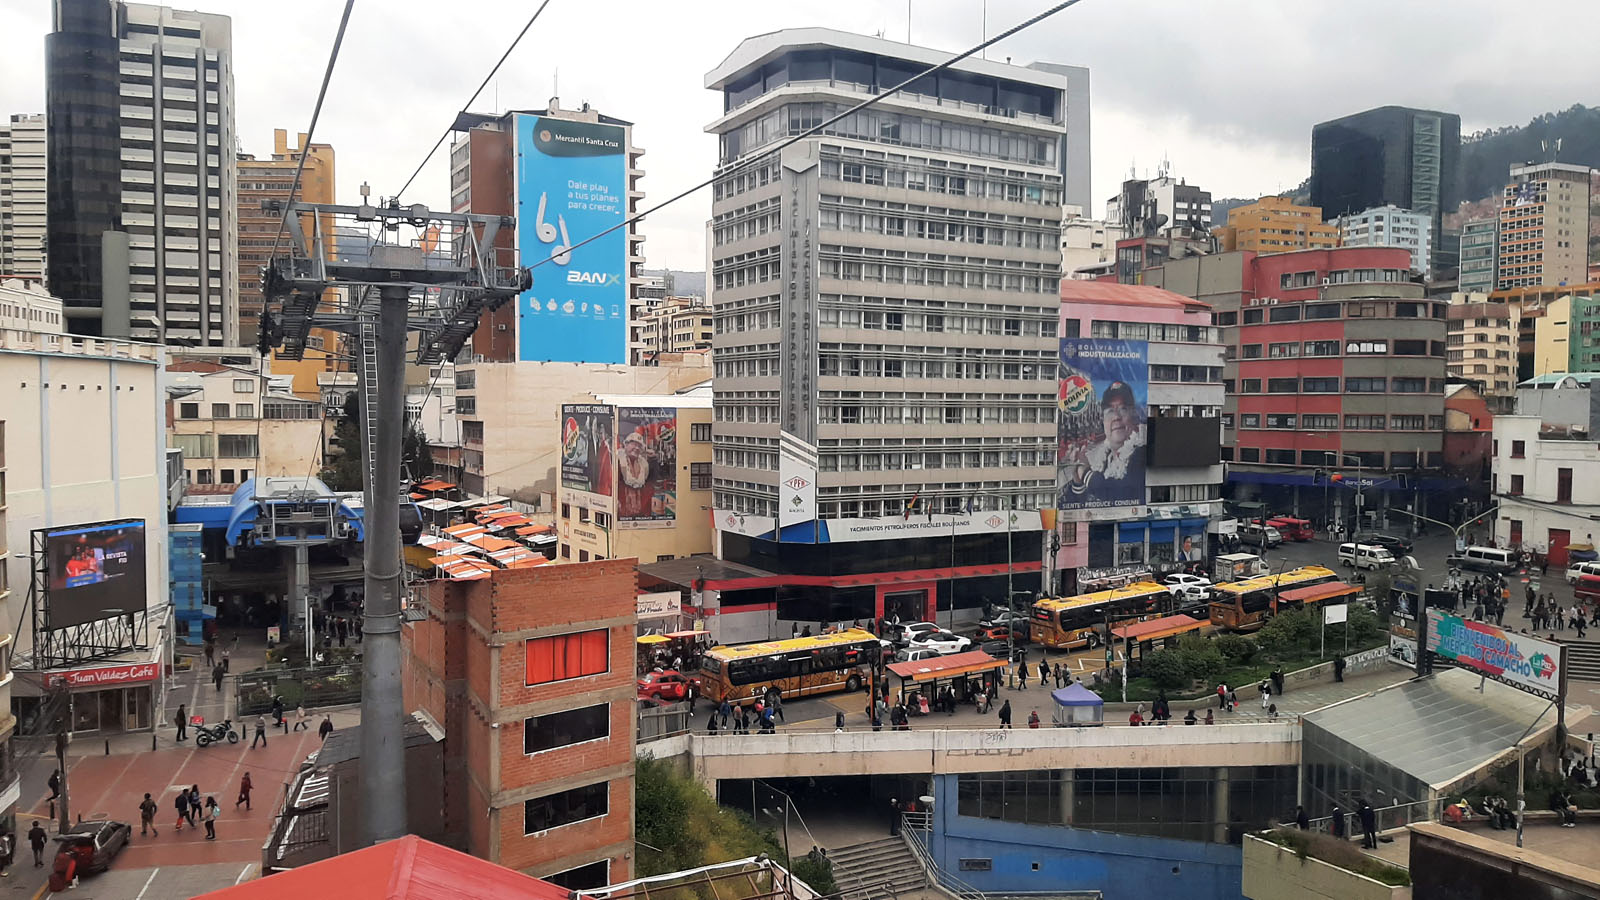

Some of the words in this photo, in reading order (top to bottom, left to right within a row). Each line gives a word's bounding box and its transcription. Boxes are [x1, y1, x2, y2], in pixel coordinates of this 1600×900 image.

[555, 134, 585, 144] Mercantil
[586, 137, 604, 146] Santa
[604, 139, 619, 147] Cruz
[568, 180, 588, 190] Dale
[590, 183, 609, 194] play
[575, 191, 589, 200] tus
[591, 193, 619, 203] planes
[568, 201, 587, 210] para
[567, 270, 620, 286] BANX
[1063, 387, 1089, 406] BOLIVIA
[1345, 479, 1373, 487] BancSol
[1085, 500, 1111, 508] PRODUCE
[1451, 623, 1508, 653] BIENVENIDOS
[1509, 641, 1520, 658] AL
[1443, 635, 1483, 661] MERCADO
[1484, 649, 1531, 678] CAMACHO
[69, 672, 94, 684] Juan
[94, 670, 130, 682] Valdez
[130, 666, 153, 678] Café
